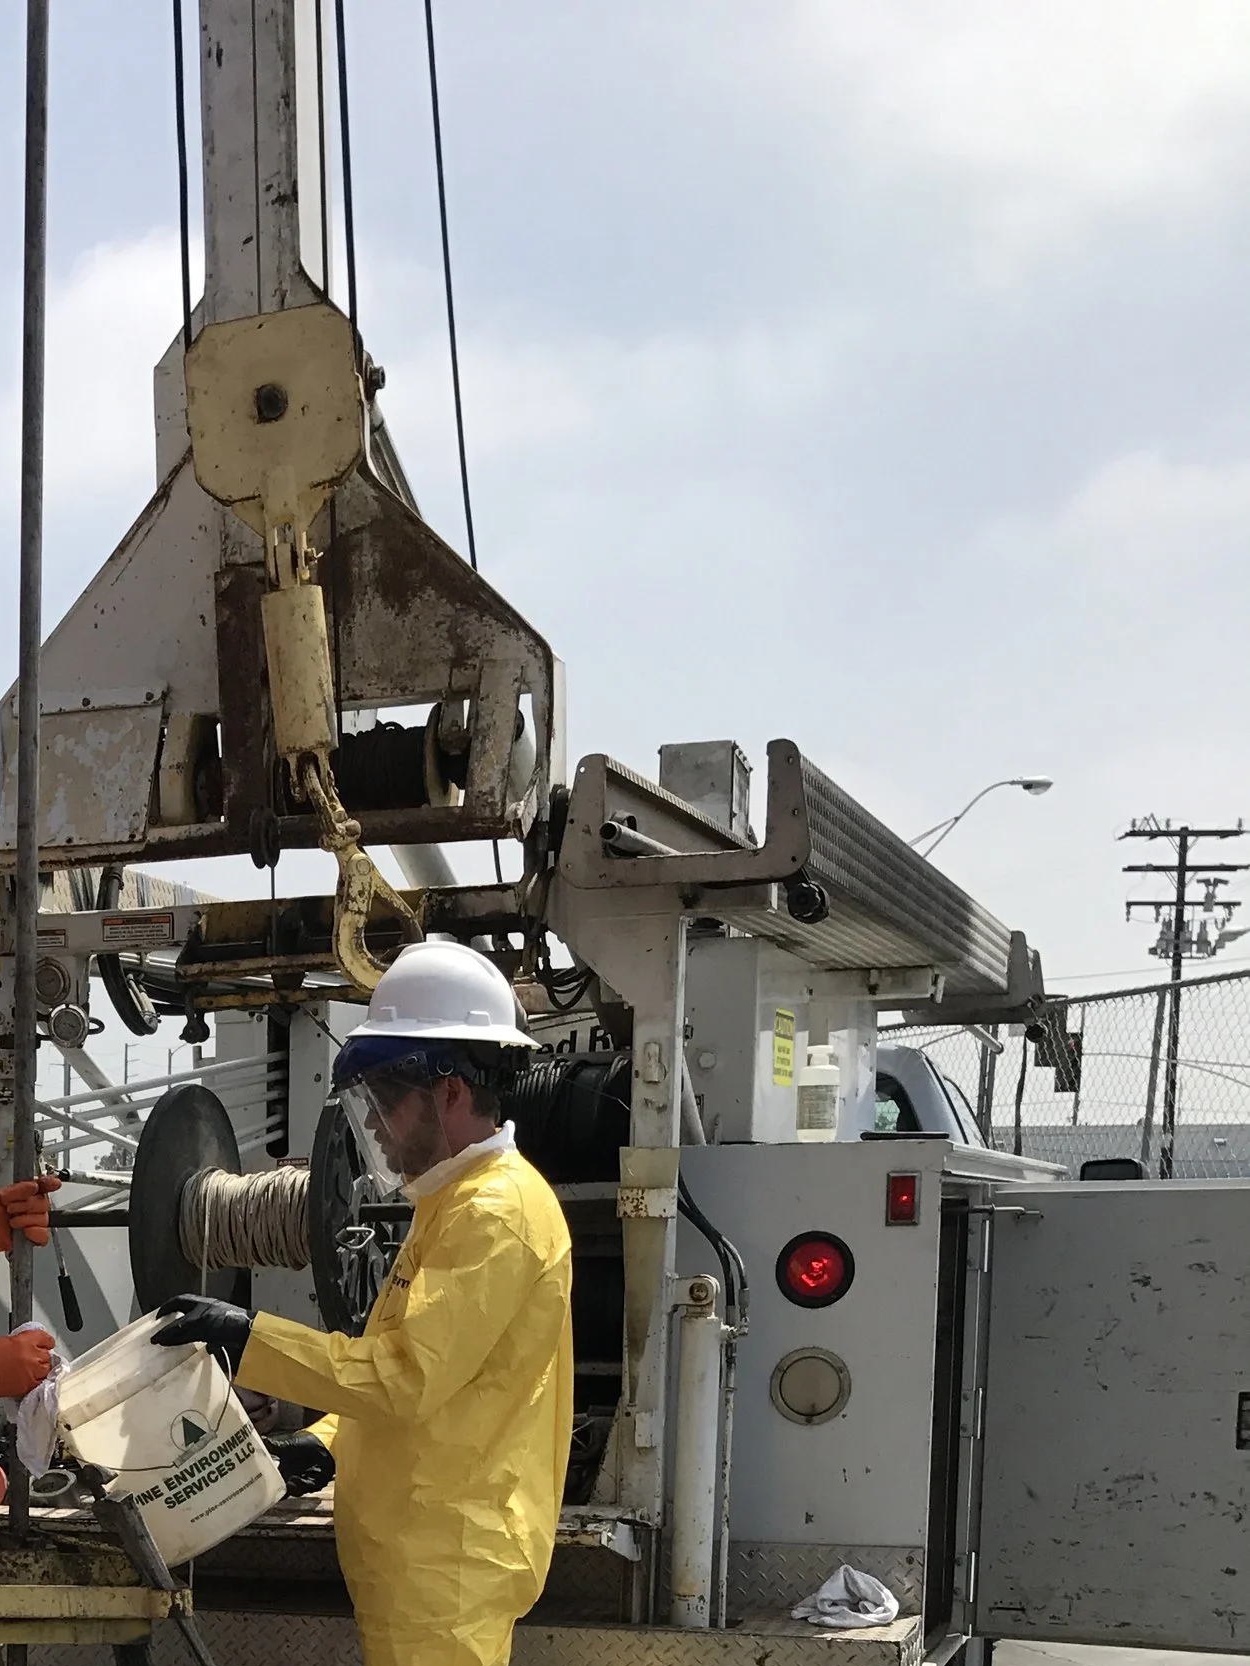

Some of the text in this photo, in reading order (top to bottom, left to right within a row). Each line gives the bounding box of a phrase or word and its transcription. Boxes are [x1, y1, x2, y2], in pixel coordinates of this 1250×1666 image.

[134, 1422, 254, 1506] INE ENVIRONMENT
[163, 1441, 256, 1509] SERVICES LLC
